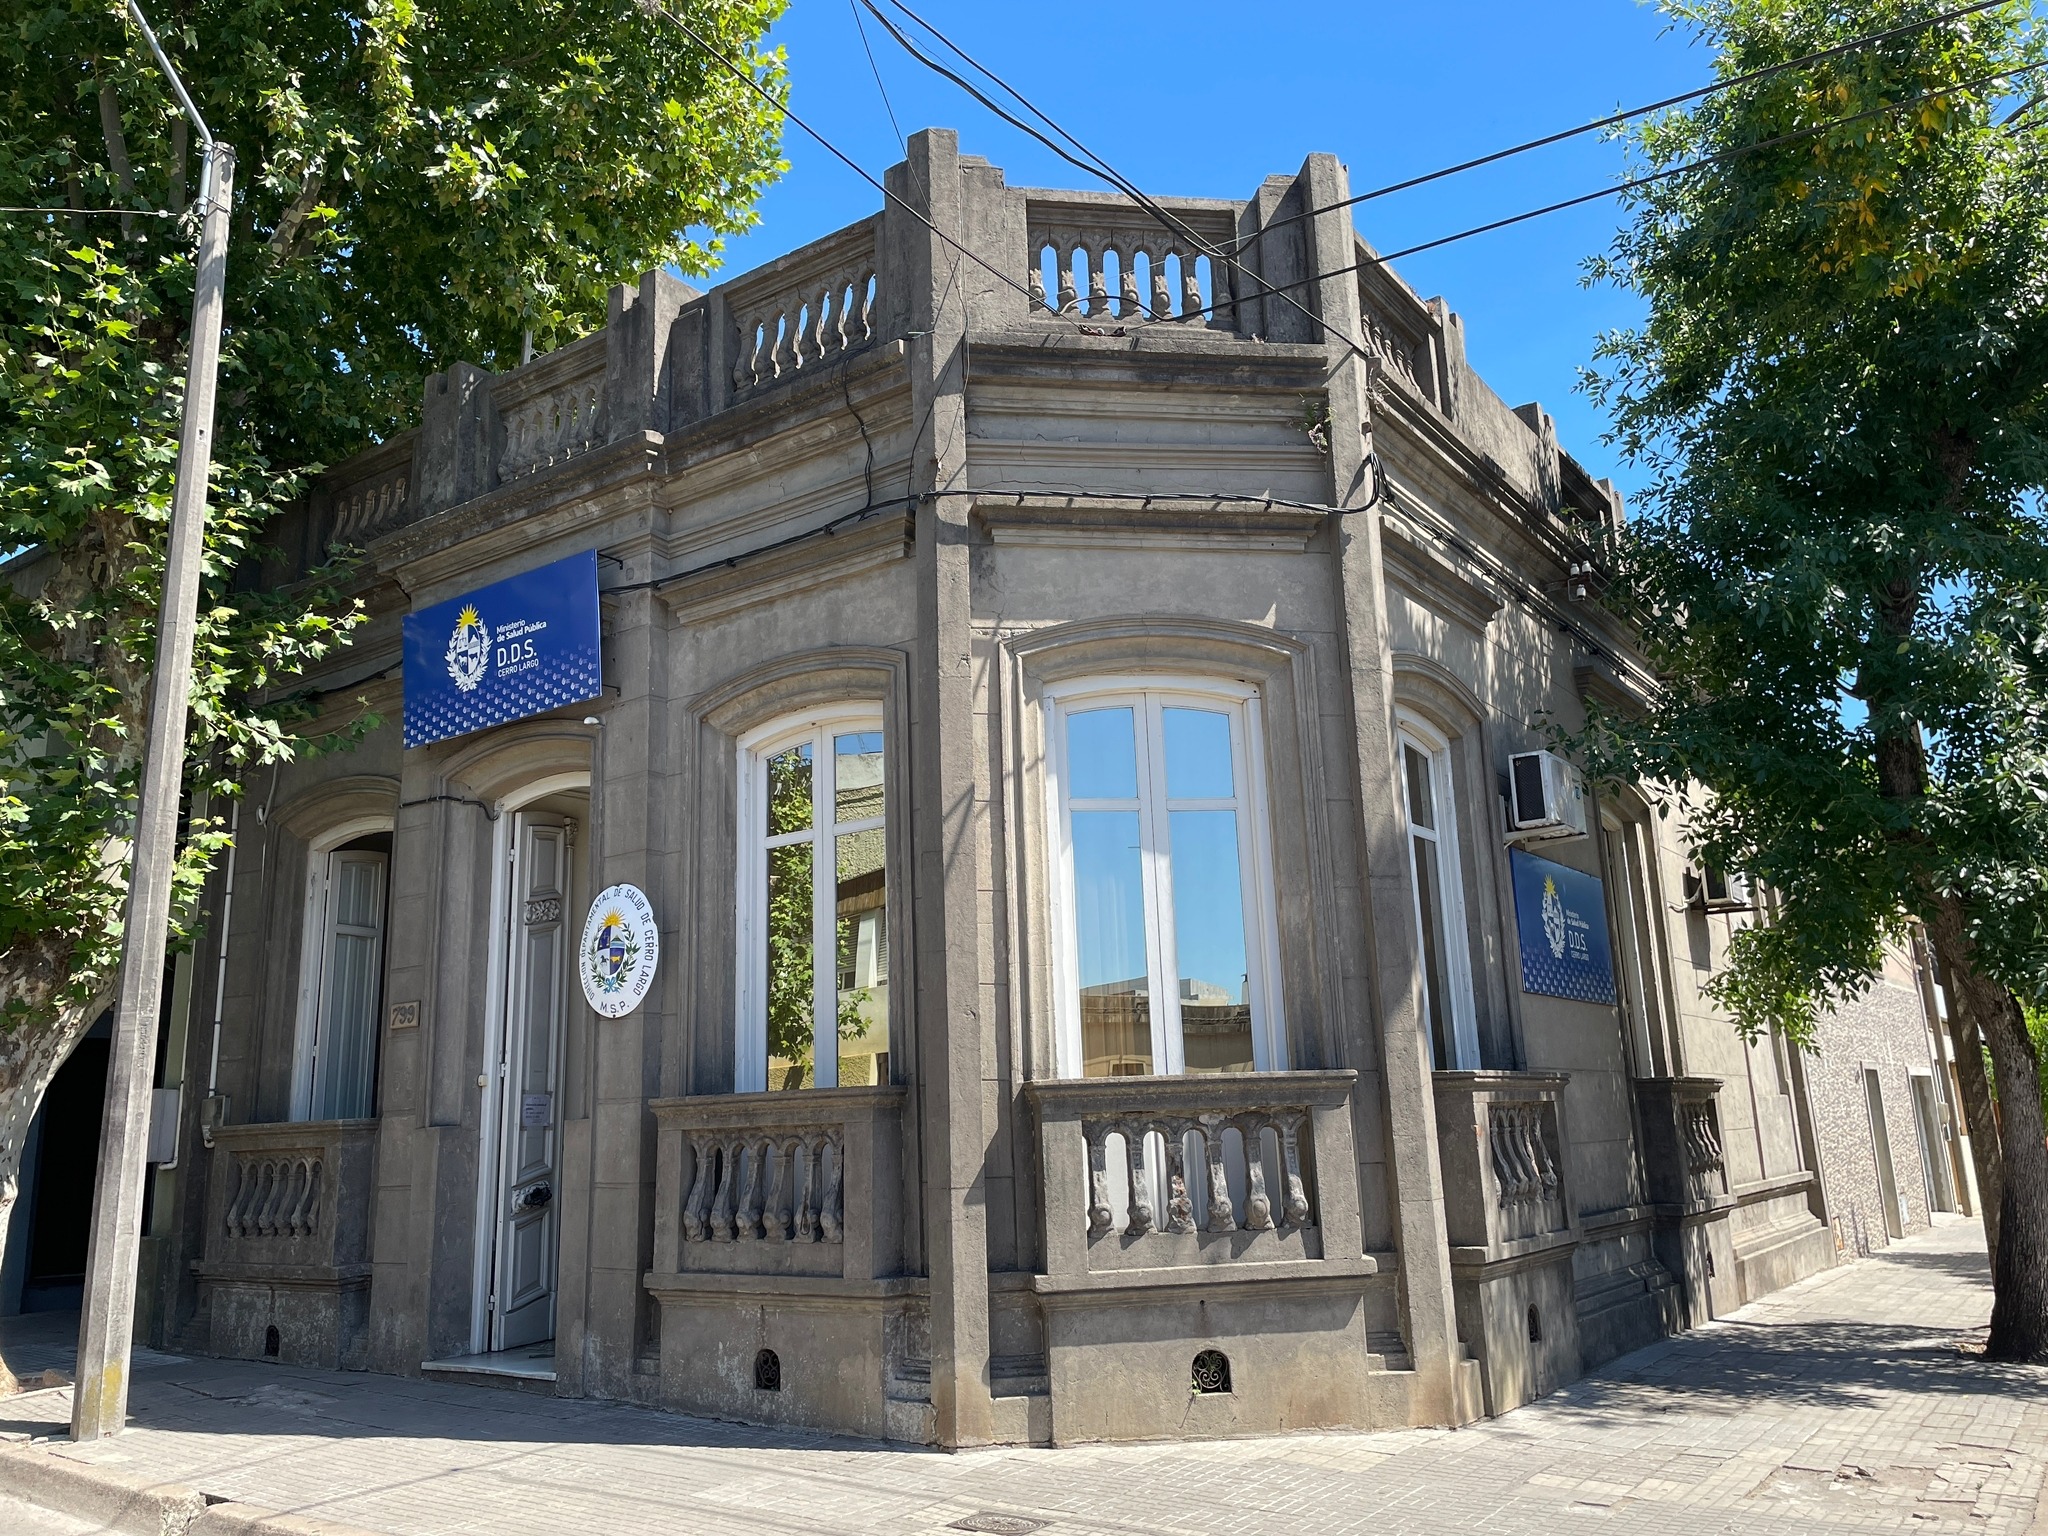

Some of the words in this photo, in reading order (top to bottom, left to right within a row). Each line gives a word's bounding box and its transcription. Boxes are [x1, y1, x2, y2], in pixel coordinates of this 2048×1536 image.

[496, 618, 526, 634] Ministerio
[496, 634, 505, 643] de
[506, 627, 523, 640] Salud
[524, 621, 547, 634] Pública
[497, 638, 537, 667] D.D.S.
[497, 665, 518, 677] CERRO
[518, 658, 539, 671] LARGO
[613, 887, 623, 898] DE
[624, 888, 645, 911] SALUD
[580, 892, 611, 958] DEPARTAMENTAL
[640, 912, 652, 926] DE
[644, 929, 654, 961] CERRO
[633, 965, 652, 997] LARGO
[392, 1005, 415, 1026] 799
